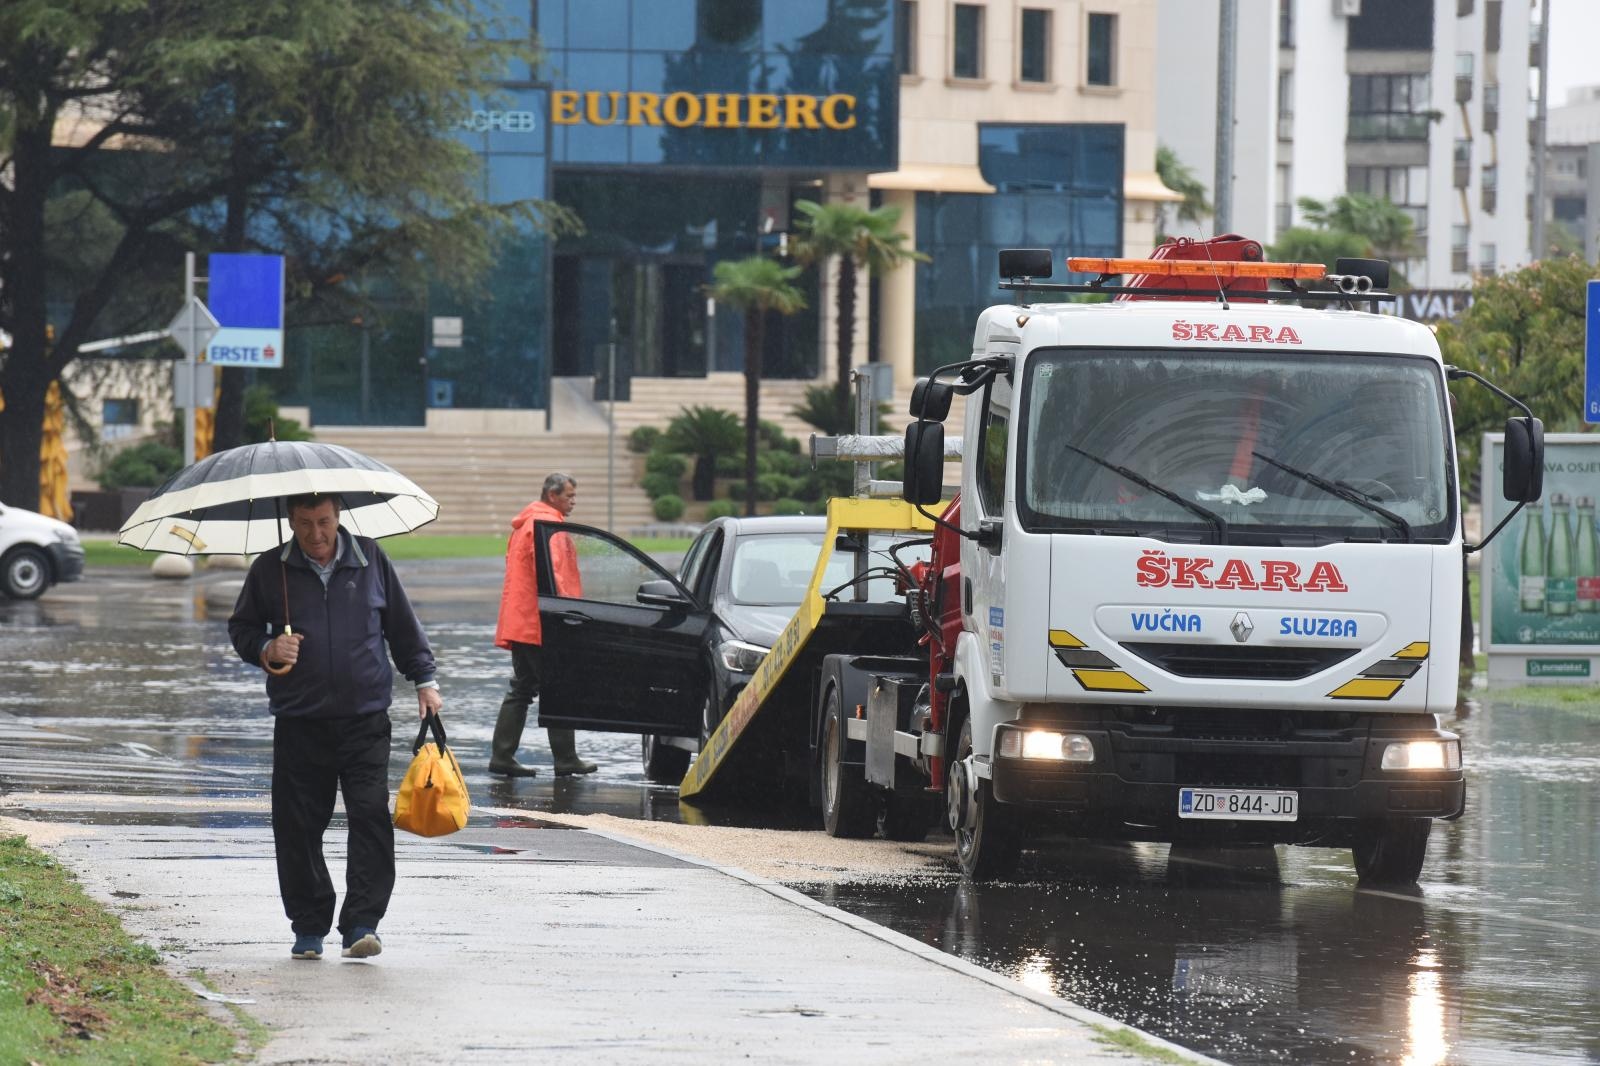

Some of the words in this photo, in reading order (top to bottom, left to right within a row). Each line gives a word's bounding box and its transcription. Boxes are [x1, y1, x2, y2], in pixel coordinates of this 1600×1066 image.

[551, 90, 857, 129] EUROHERC
[1172, 320, 1302, 344] ŠKARA
[211, 346, 259, 361] ERSTE
[1136, 549, 1349, 593] ŠKARA
[1131, 609, 1202, 632] VUČNA
[1280, 617, 1358, 637] SLUZBA
[1194, 793, 1215, 812] ZD
[1229, 795, 1293, 814] 844-JD
